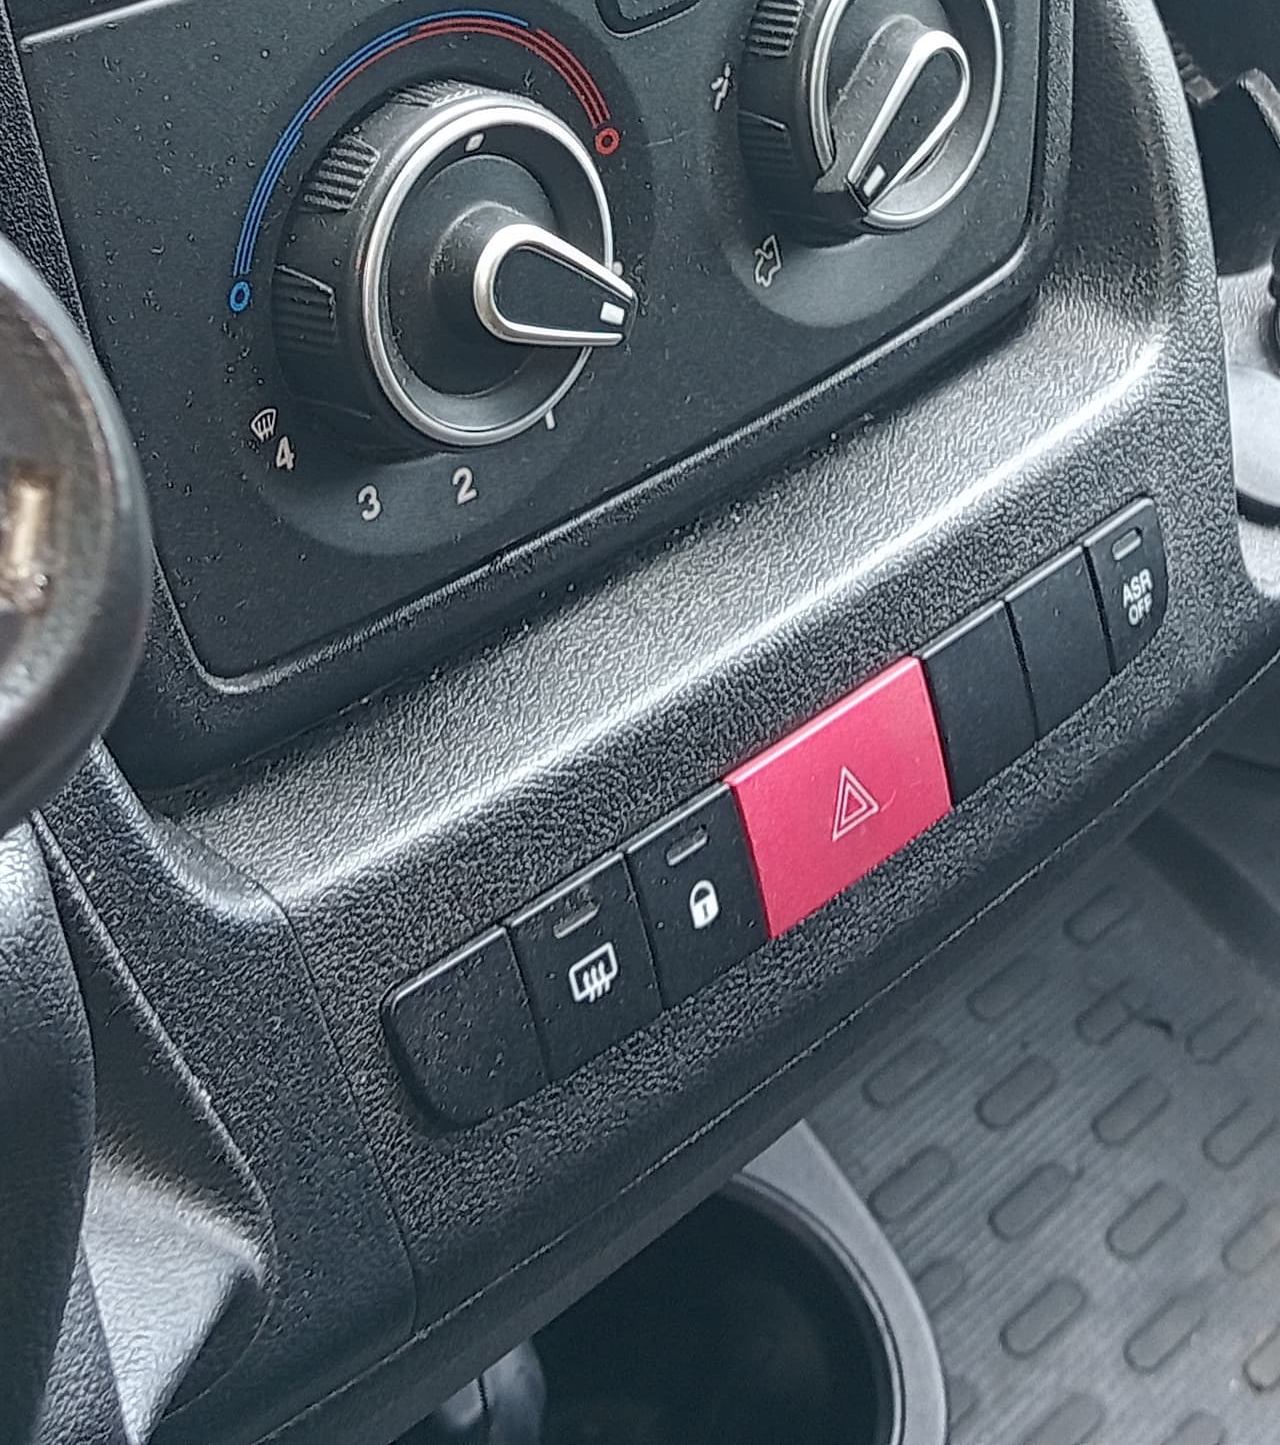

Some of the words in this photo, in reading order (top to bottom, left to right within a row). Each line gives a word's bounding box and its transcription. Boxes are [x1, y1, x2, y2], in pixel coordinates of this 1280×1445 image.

[275, 435, 295, 471] 4
[356, 484, 382, 522] 3
[451, 466, 478, 506] 2
[1122, 568, 1153, 609] ASR
[1128, 592, 1153, 626] OFF
